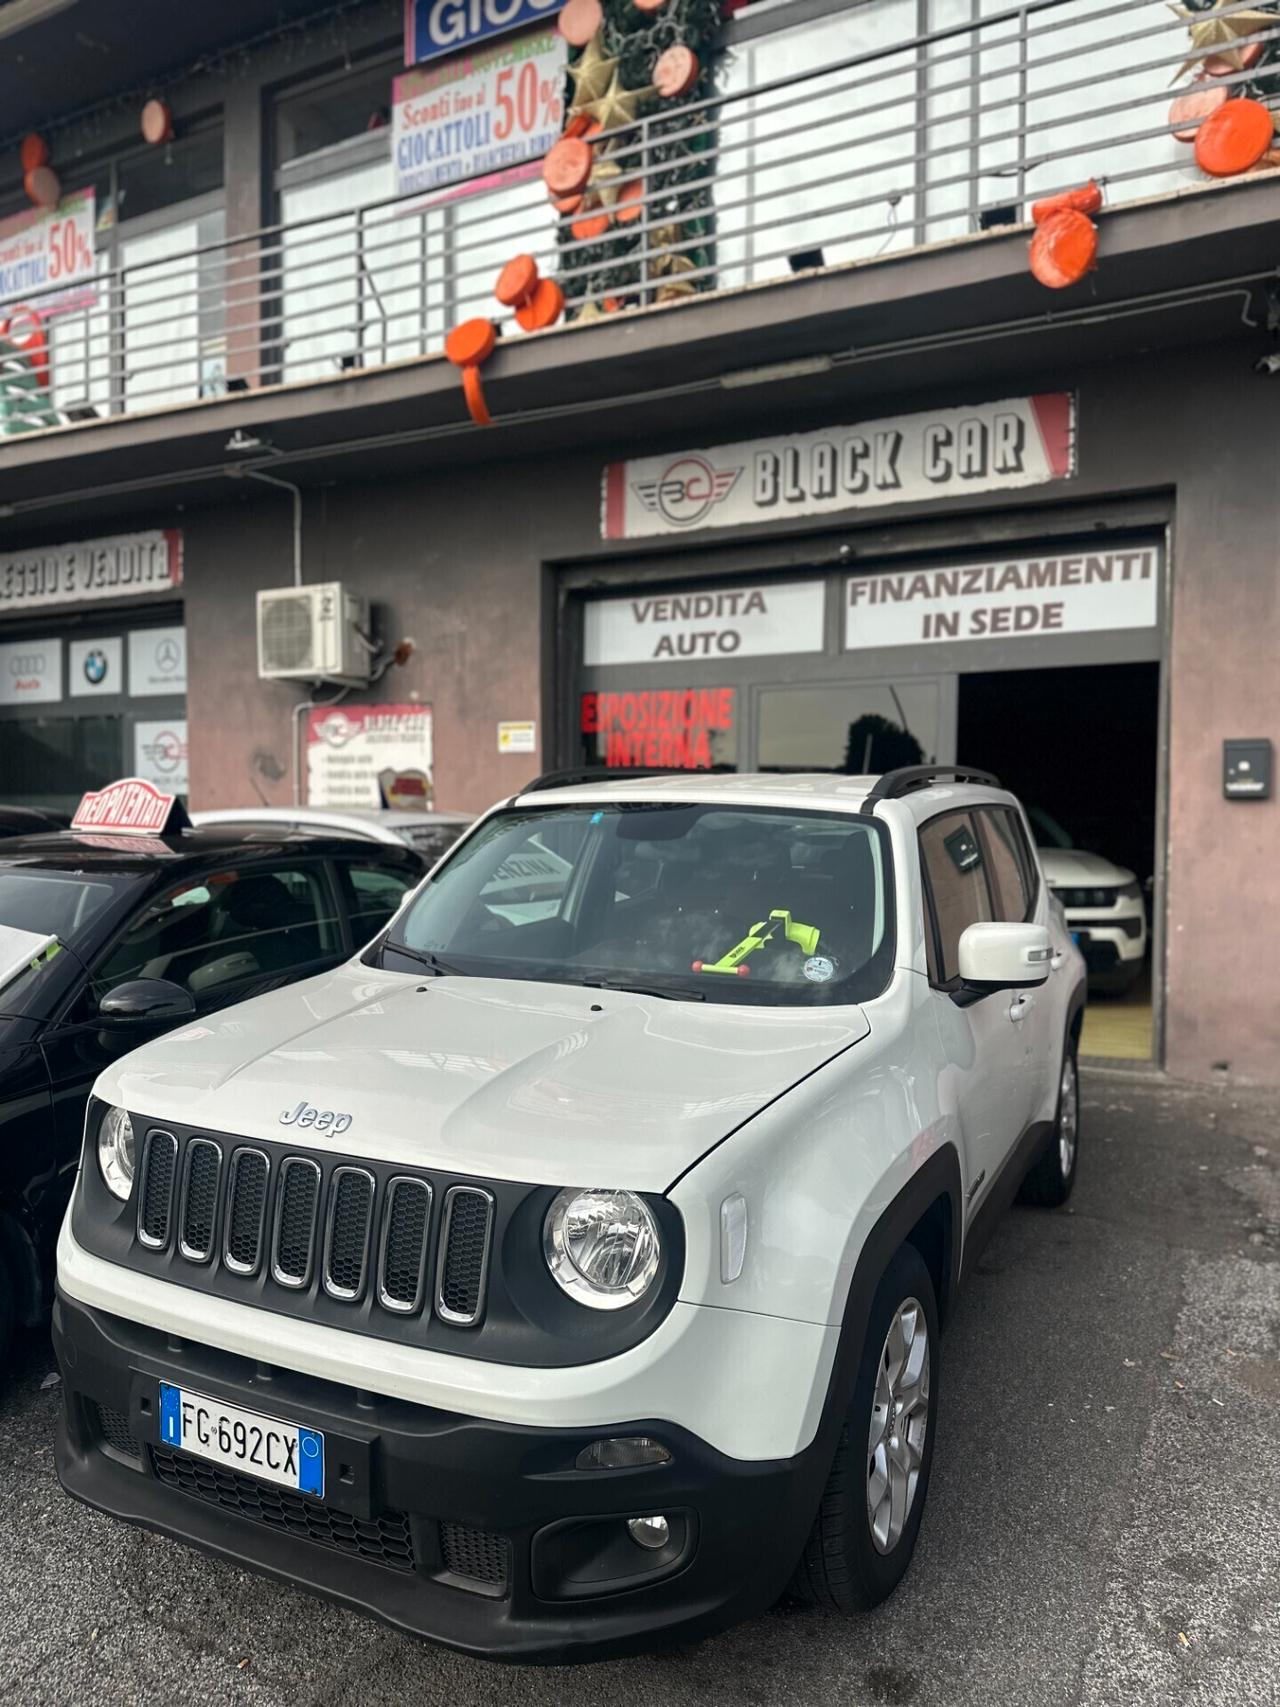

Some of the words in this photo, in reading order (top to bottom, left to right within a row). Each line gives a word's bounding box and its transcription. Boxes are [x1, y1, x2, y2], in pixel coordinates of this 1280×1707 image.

[493, 61, 562, 140] 50%
[397, 110, 491, 172] GIOCATTOLI
[49, 217, 92, 278] 50%
[754, 430, 902, 507] BLACK
[923, 412, 1025, 484] CAR
[0, 557, 59, 600] EGGIO
[63, 551, 76, 592] E
[80, 541, 171, 590] VENDITA
[849, 551, 1153, 607] FINANZIAMENTI
[632, 590, 767, 624] VENDITA
[922, 612, 958, 639] IN
[969, 602, 1065, 636] SEDE
[653, 630, 741, 658] AUTO
[581, 688, 734, 733] ESPOSIZIONE
[606, 731, 712, 768] INTERNA
[75, 784, 169, 828] NEOPATENTATI
[279, 1101, 353, 1138] Jeep
